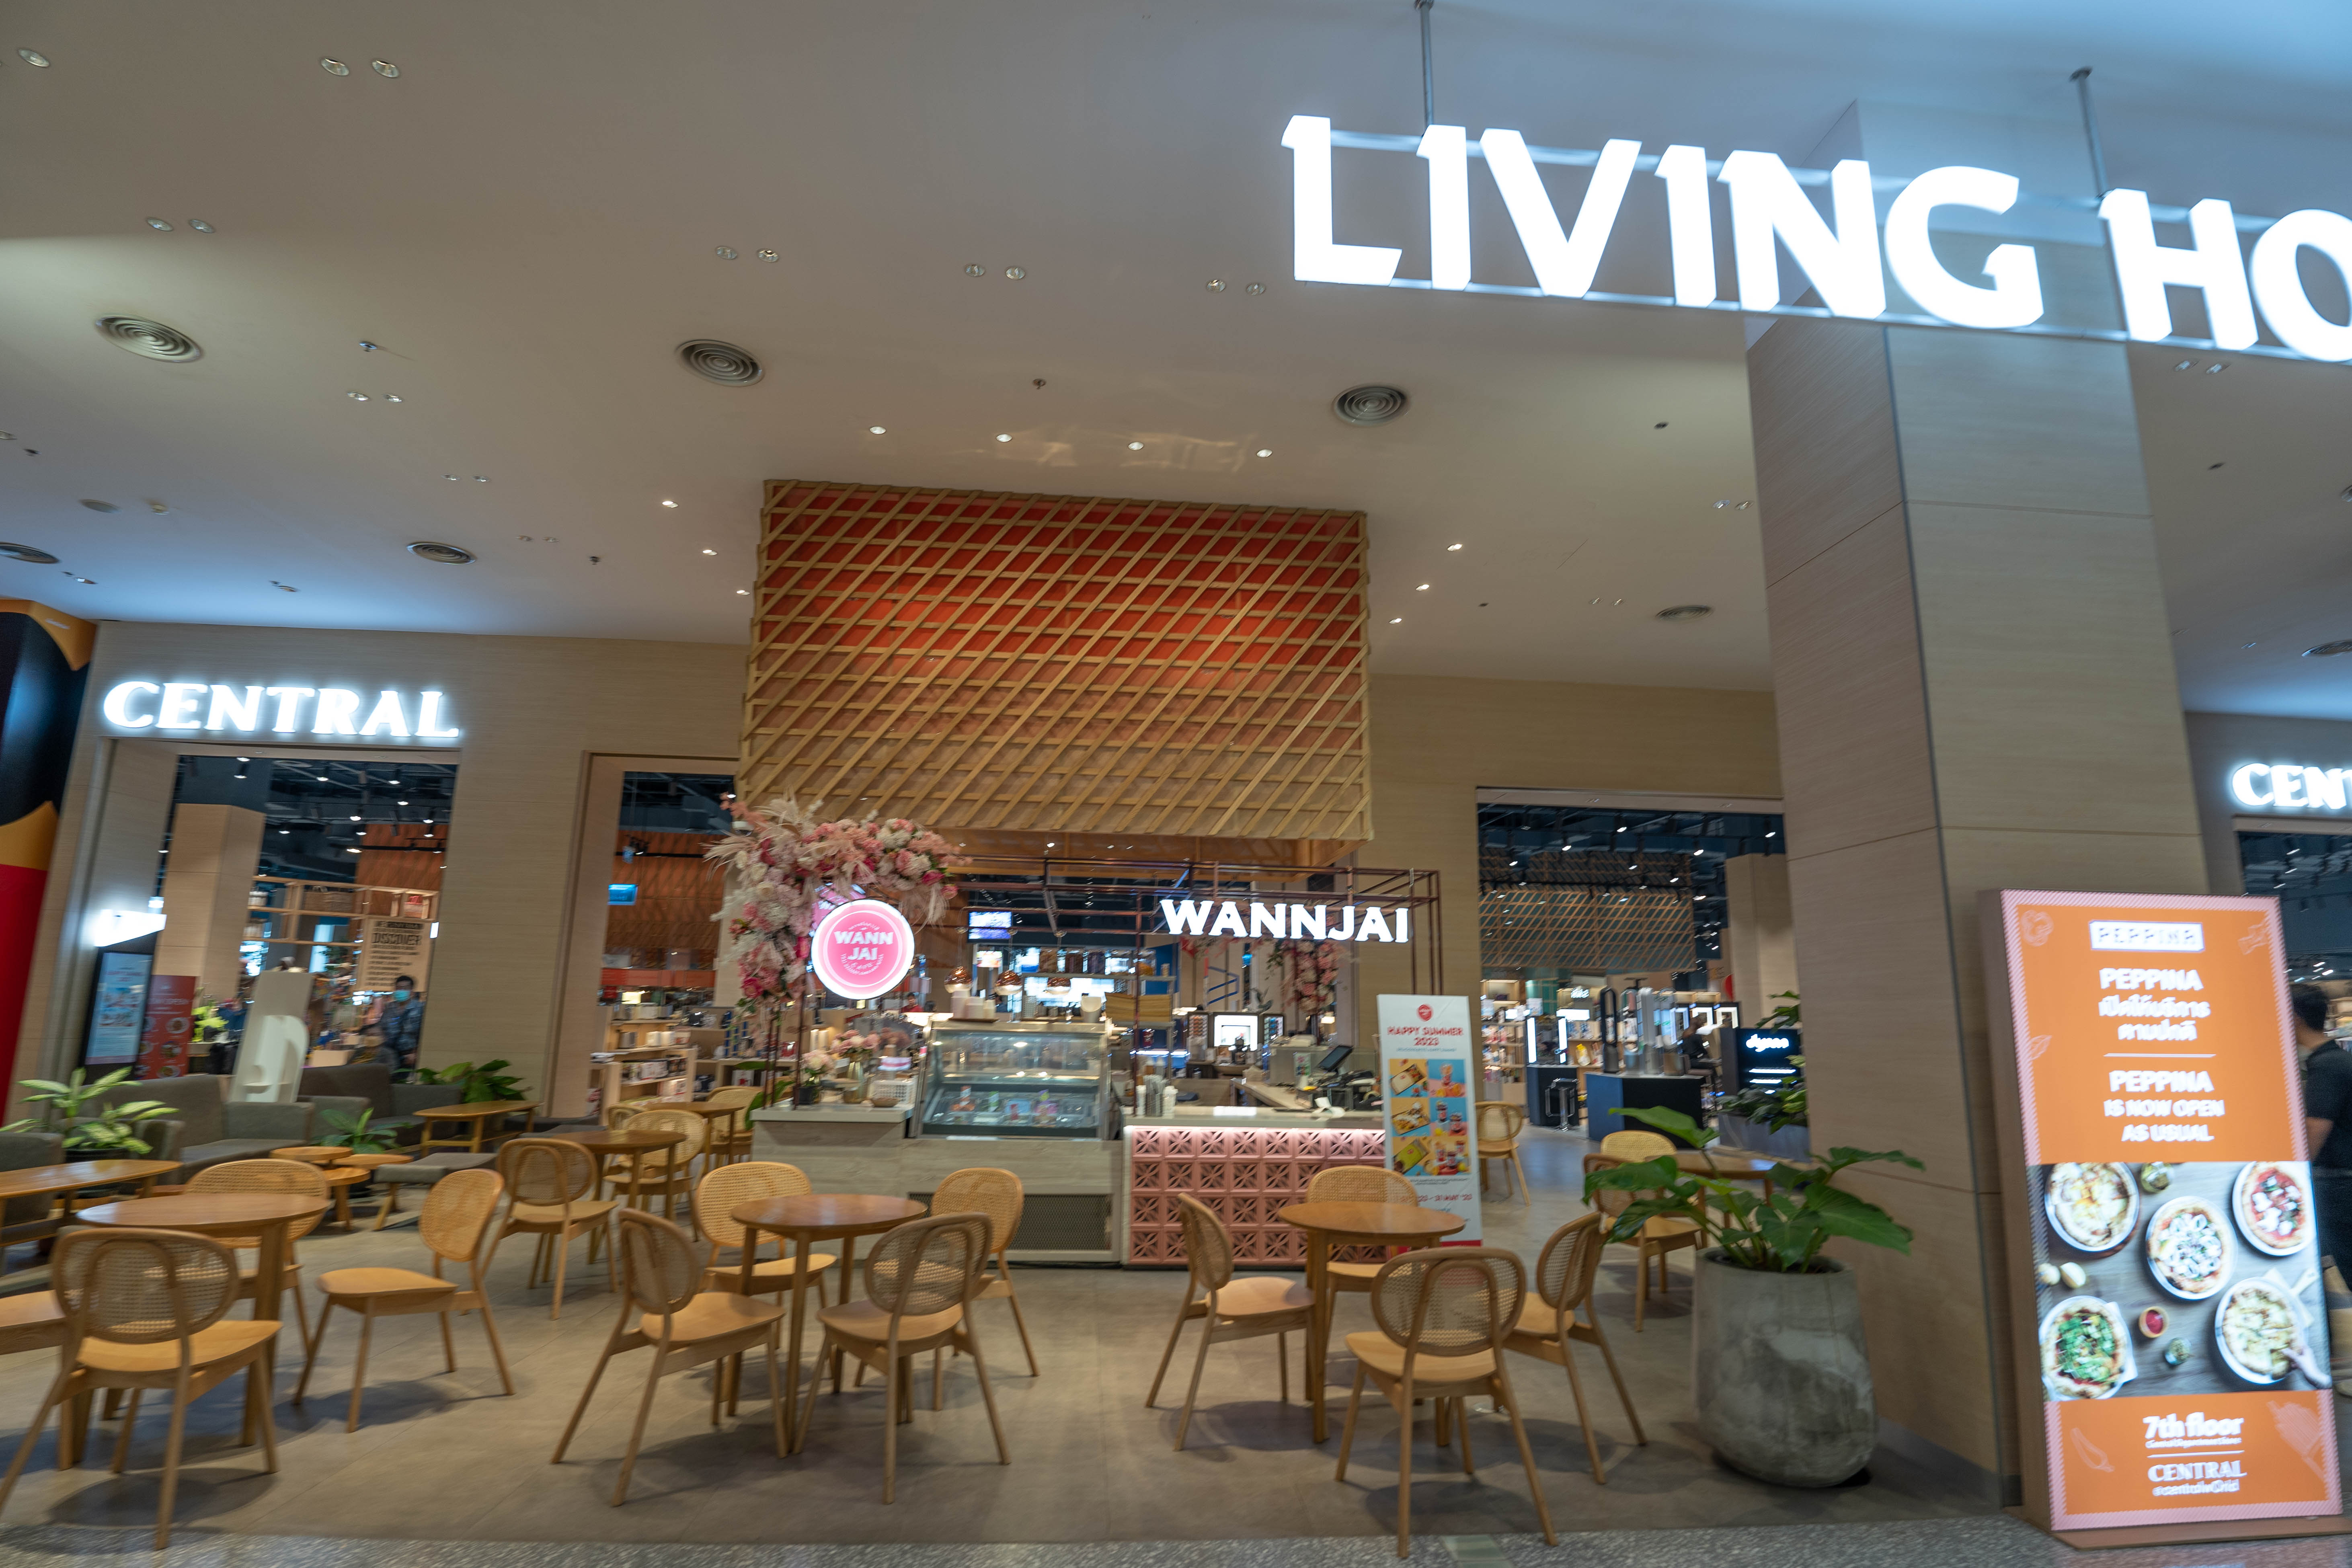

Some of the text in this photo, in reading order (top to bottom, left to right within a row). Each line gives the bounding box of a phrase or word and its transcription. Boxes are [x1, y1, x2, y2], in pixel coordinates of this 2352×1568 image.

[1281, 115, 2043, 329] LIVING
[104, 681, 460, 737] CENTRAL
[1160, 899, 1408, 943] WANNJAI
[834, 931, 894, 944] WANN
[2098, 926, 2196, 945] PEPPINA
[848, 947, 878, 960] JAI
[2099, 968, 2204, 991] PEPPINA
[1387, 1026, 1463, 1036] HAPPY SUMMER
[1414, 1037, 1439, 1046] 2023
[1746, 1034, 1789, 1052] dyson
[2109, 1070, 2214, 1092] PEPPINA
[2104, 1099, 2225, 1117] IS NOW OPEN
[2121, 1124, 2215, 1142] AS USUAL
[2143, 1412, 2245, 1439] 7th floor
[2148, 1460, 2247, 1482] CENTRAL
